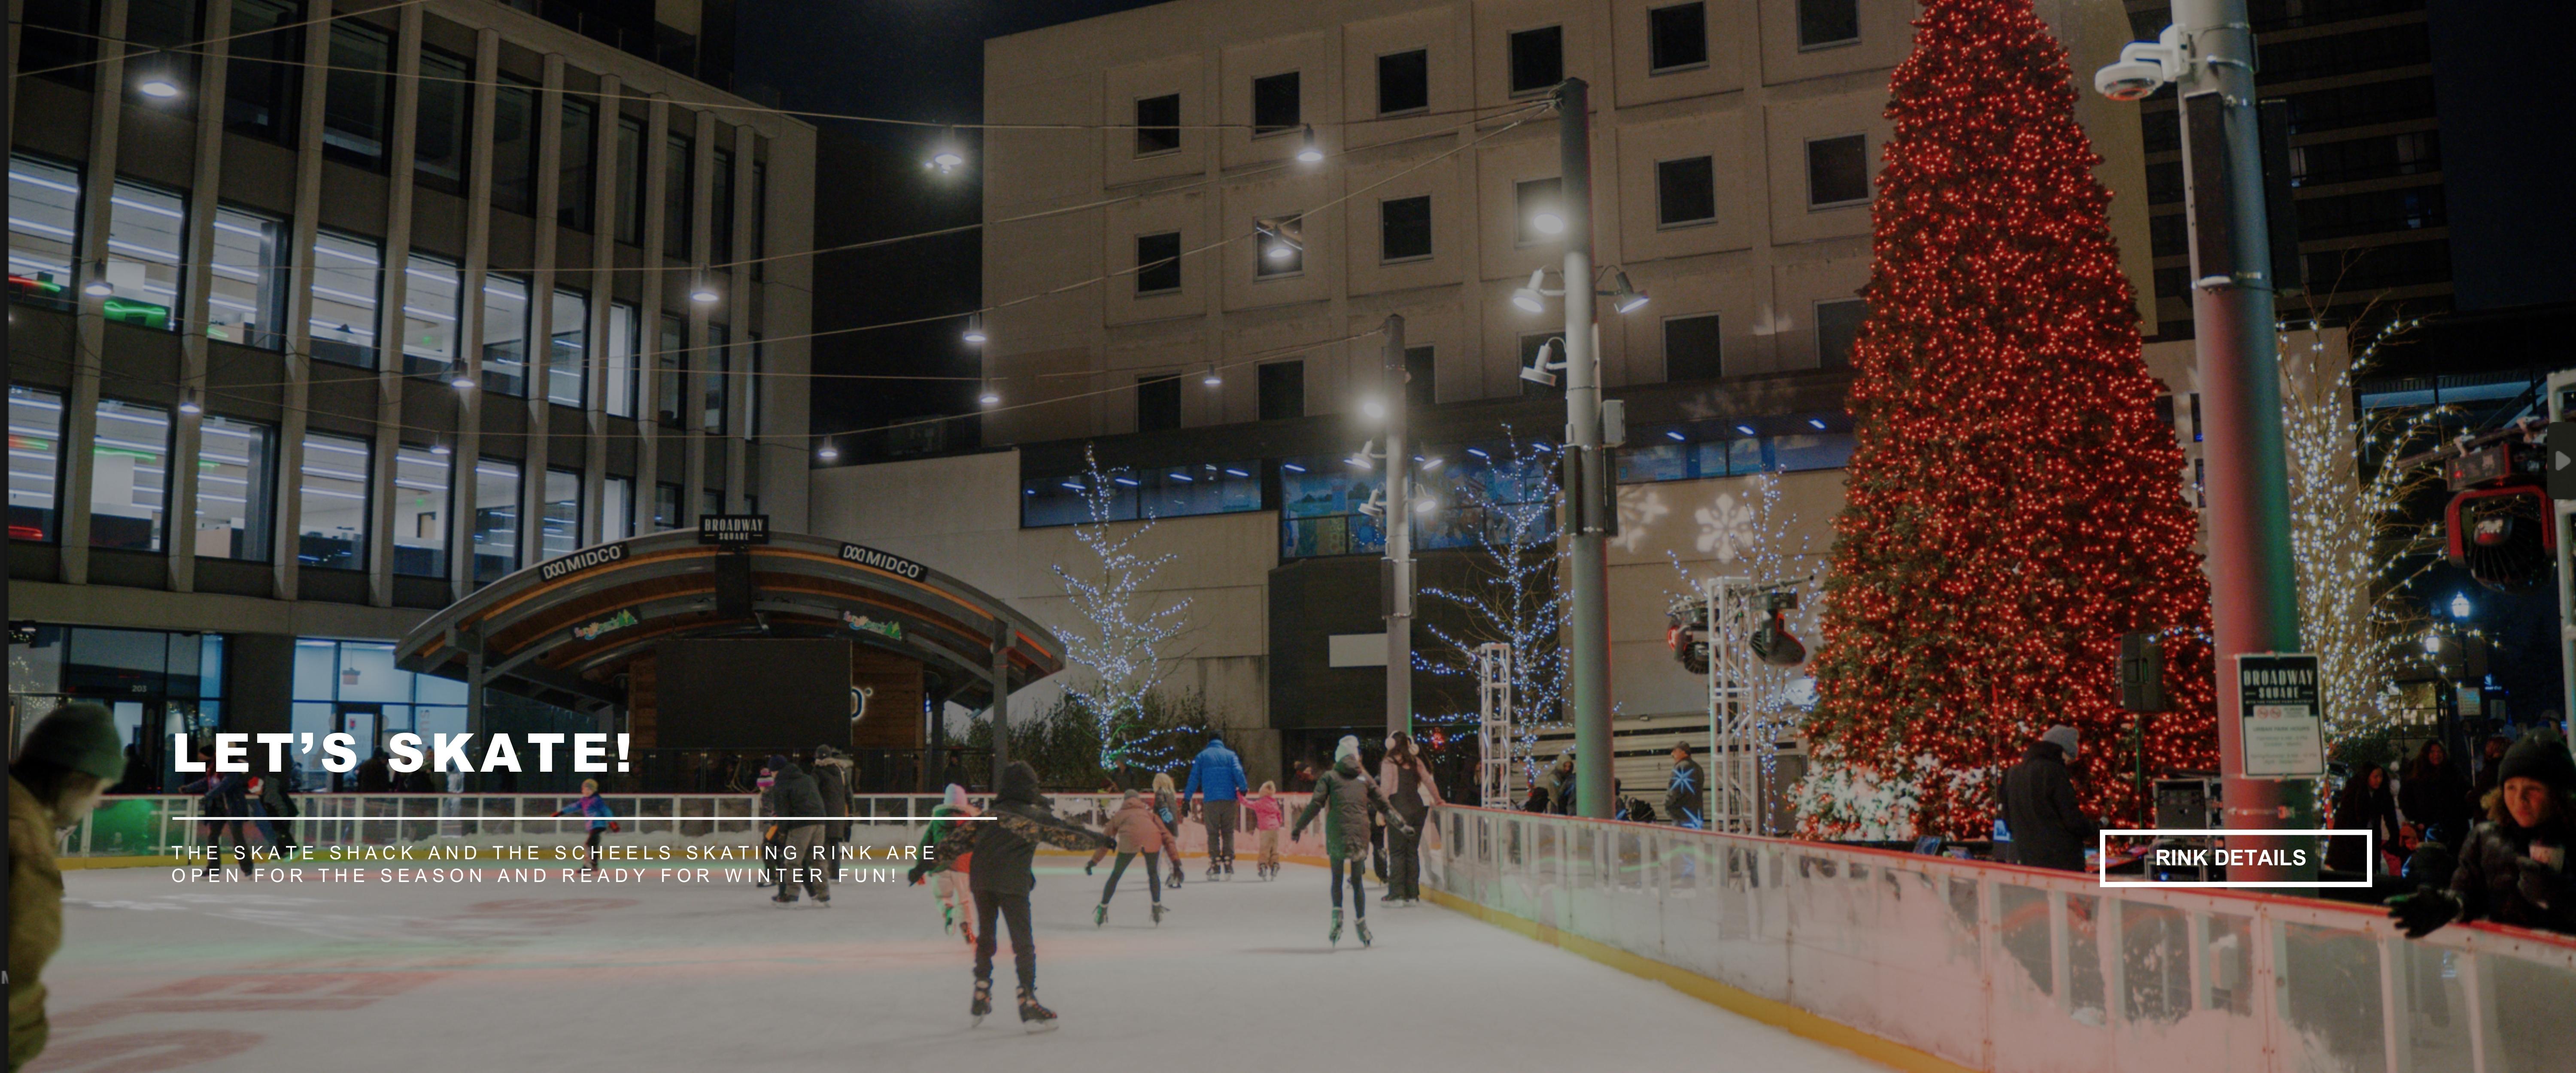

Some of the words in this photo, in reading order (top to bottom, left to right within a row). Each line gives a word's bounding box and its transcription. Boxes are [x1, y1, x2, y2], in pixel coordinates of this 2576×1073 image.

[705, 518, 763, 531] BROADWAY
[719, 532, 749, 540] SQUARE
[566, 545, 621, 572] MIDCO
[866, 551, 920, 578] MIDCO
[2244, 669, 2313, 686] BROADWAY
[2259, 687, 2299, 699] SQUARE
